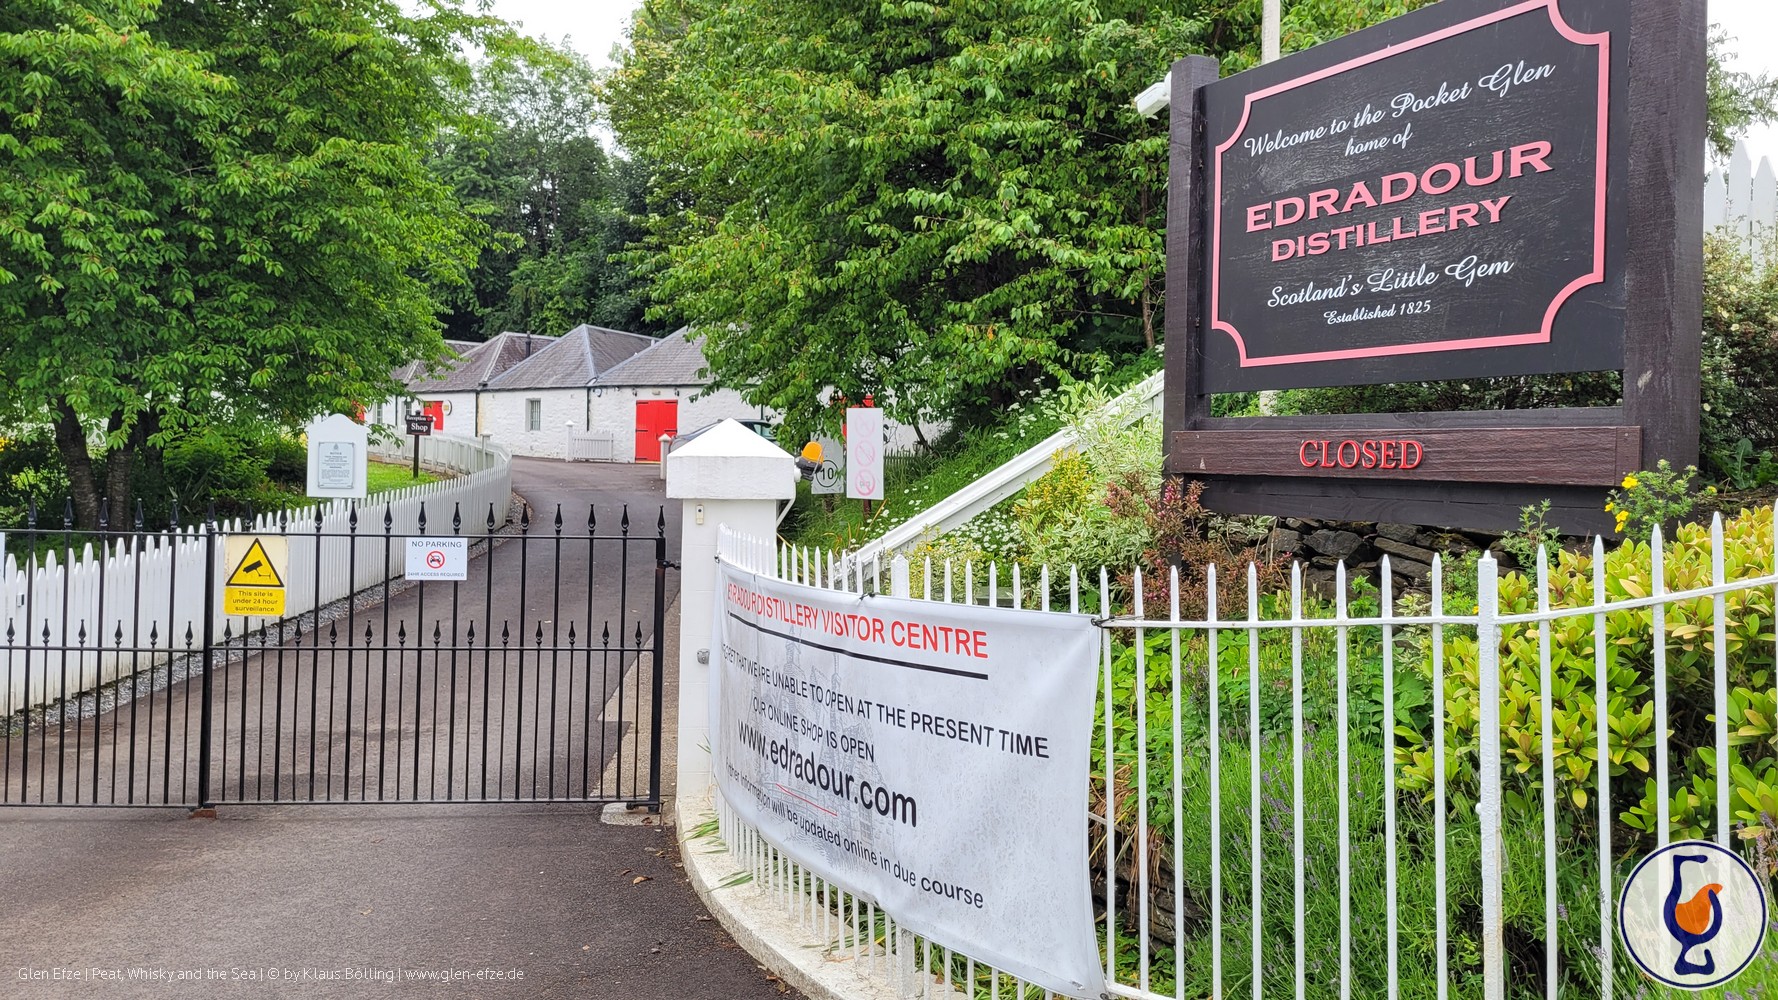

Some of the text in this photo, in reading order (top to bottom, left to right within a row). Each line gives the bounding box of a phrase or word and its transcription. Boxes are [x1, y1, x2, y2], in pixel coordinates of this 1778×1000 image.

[1244, 60, 1556, 157] Welcome to the Pocket Glen
[1345, 123, 1413, 156] home of
[1246, 140, 1553, 232] EDRADOUR
[1272, 196, 1512, 262] DISTILLERY
[1267, 255, 1515, 308] Scotland's Little Gem
[1324, 300, 1432, 325] Established 1825
[411, 422, 428, 432] Shop
[1300, 440, 1423, 468] CLOSED
[821, 470, 834, 480] 10
[758, 594, 818, 630] DISTILLERY
[822, 608, 885, 644] VISITOR
[891, 621, 988, 658] CENTRE
[753, 696, 875, 762] OUR ONLINE SHOP IS OPEN
[772, 670, 808, 698] UNABLE
[810, 684, 824, 703] TO
[826, 688, 854, 714] OPEN
[857, 700, 872, 718] AT
[876, 703, 906, 728] THE
[910, 711, 994, 748] PRESENT
[998, 728, 1049, 759] TIME
[738, 719, 917, 828] www.edradour.com
[772, 800, 785, 818] will
[787, 805, 798, 825] be
[800, 814, 841, 847] updated
[844, 836, 878, 866] online
[879, 850, 891, 872] in
[893, 860, 917, 887] due
[920, 876, 984, 909] course
